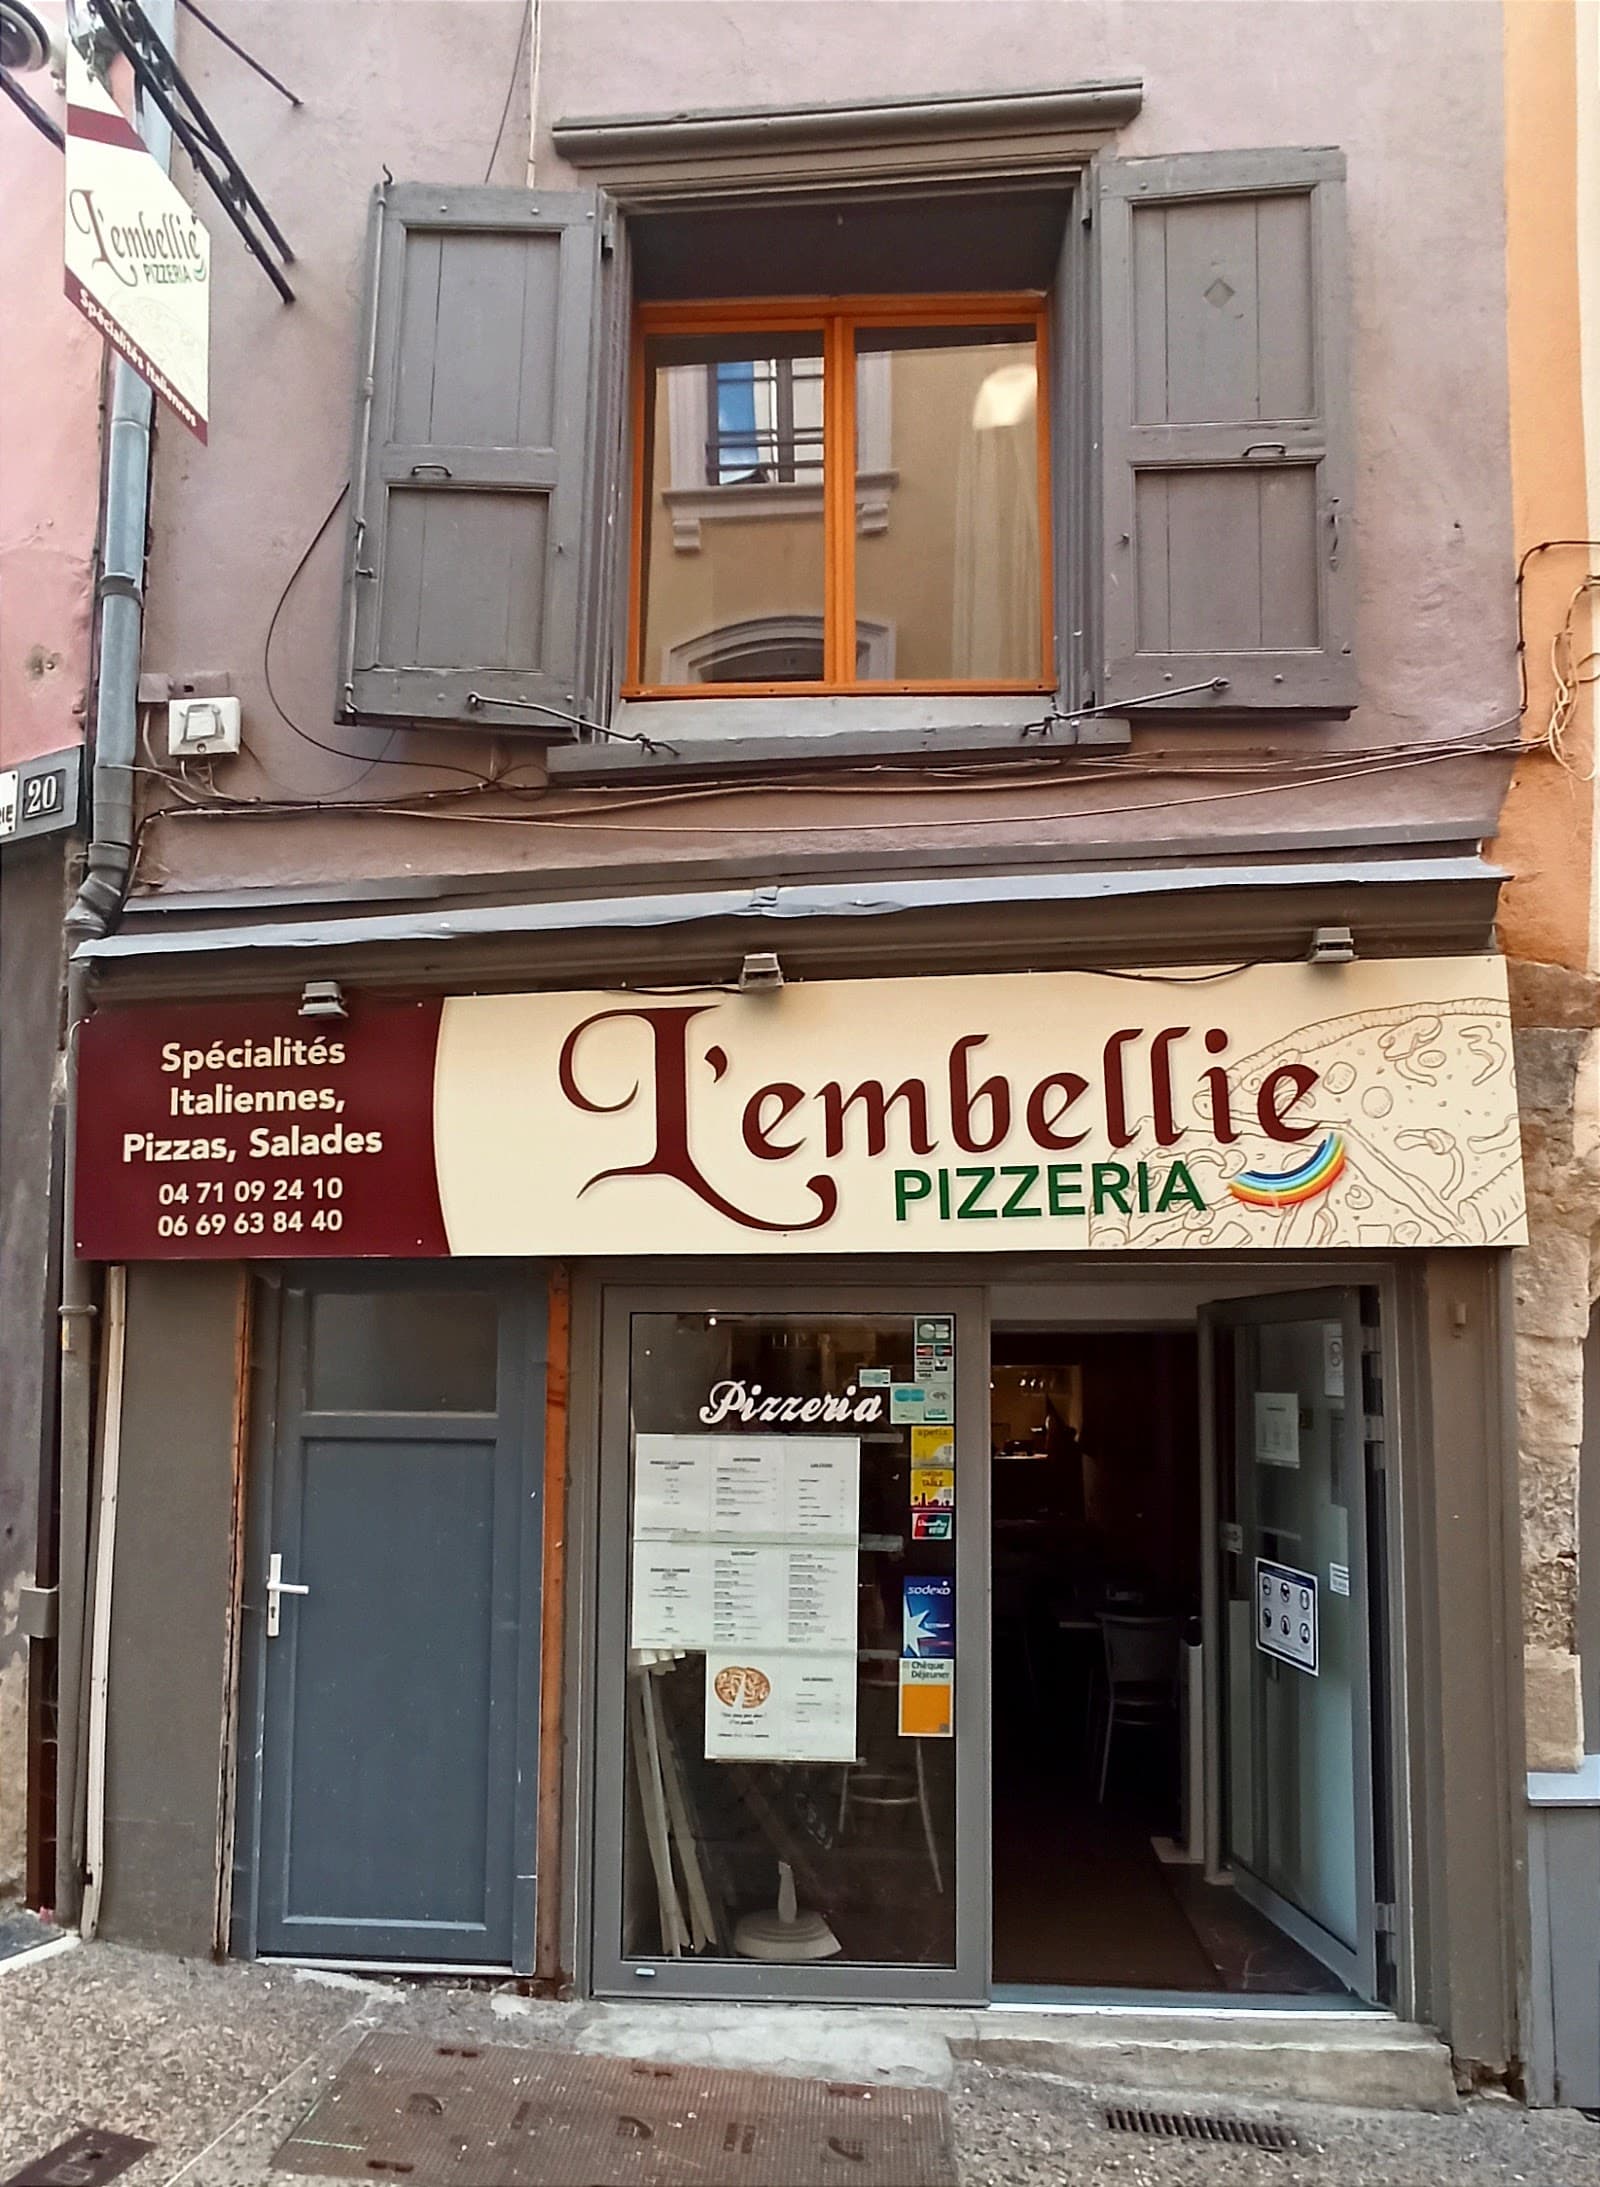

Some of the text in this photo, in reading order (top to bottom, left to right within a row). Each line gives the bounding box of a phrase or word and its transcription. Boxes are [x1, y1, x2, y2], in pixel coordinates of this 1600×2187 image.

[143, 263, 192, 284] PIZZERIA
[80, 288, 197, 427] Spécialités Italiennes
[27, 775, 57, 813] 20
[161, 1036, 345, 1079] Spécialités
[170, 1083, 345, 1116] Italiennes,
[559, 1004, 1321, 1231] L'embellie
[123, 1123, 383, 1162] Pizzas, Salades
[158, 1177, 343, 1205] 04 71 09 24 10
[894, 1159, 1206, 1221] PIZZERIA
[157, 1210, 342, 1237] 06 69 63 84 40
[700, 1380, 882, 1424] Pizzeria
[908, 1581, 950, 1595] sodexo
